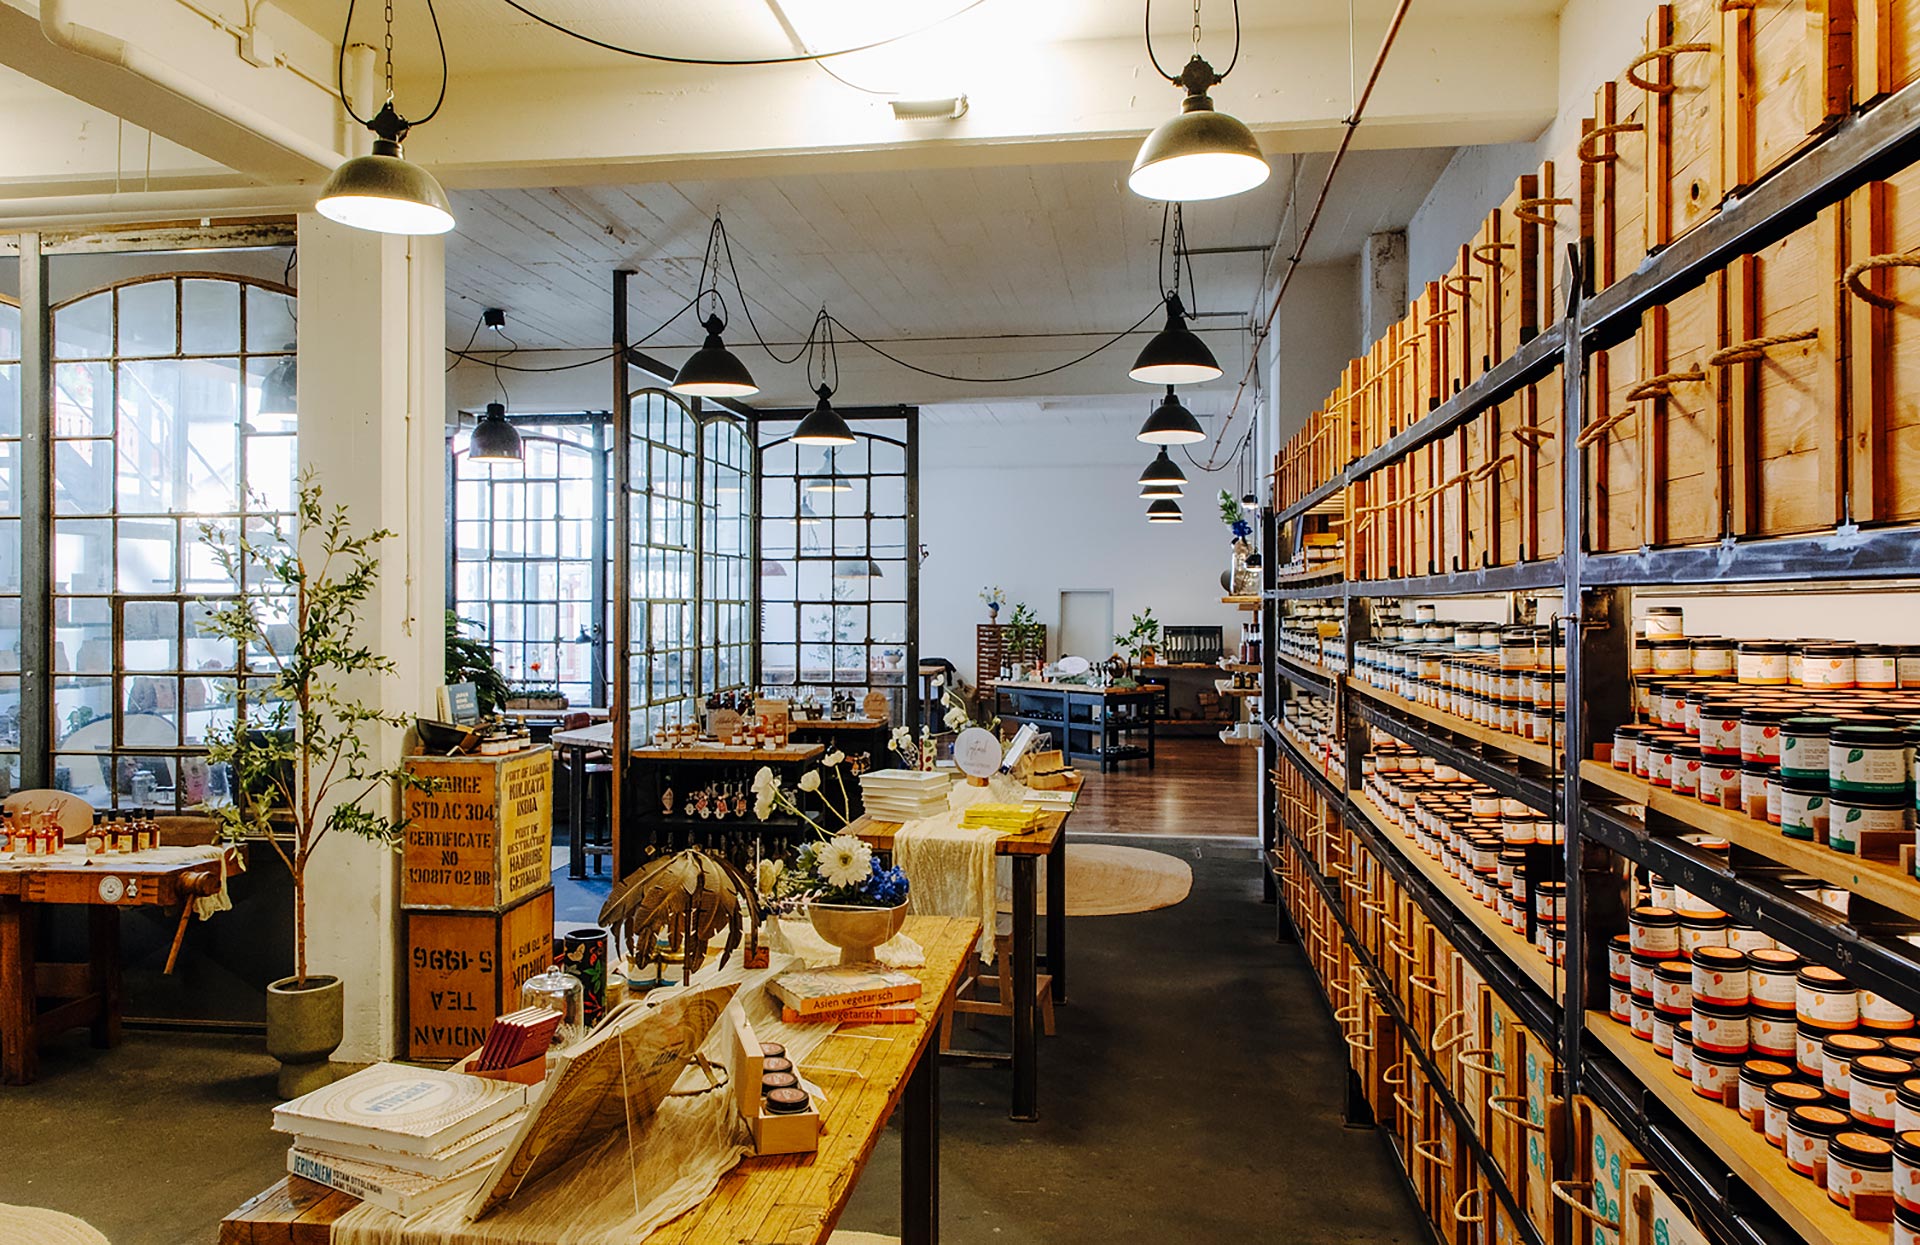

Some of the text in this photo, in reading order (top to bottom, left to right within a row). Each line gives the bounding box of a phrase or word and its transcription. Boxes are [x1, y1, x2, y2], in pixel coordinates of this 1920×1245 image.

[424, 776, 482, 794] ARGE
[509, 776, 545, 800] KOLKATA
[411, 801, 494, 821] STD AC 304
[517, 797, 538, 817] INDIA
[409, 831, 491, 849] CERTIFICATE
[515, 822, 539, 840] PORT OF
[441, 850, 459, 866] NO
[509, 847, 543, 873] HAMBURG
[454, 870, 472, 886] 02
[509, 867, 543, 893] GERMANY
[430, 990, 478, 1012] TEA
[813, 990, 893, 1010] Asien vegetarisch
[825, 1008, 882, 1021] vegetarisch
[415, 1025, 488, 1047] NDIAN
[293, 1155, 332, 1185] JERUSALEM
